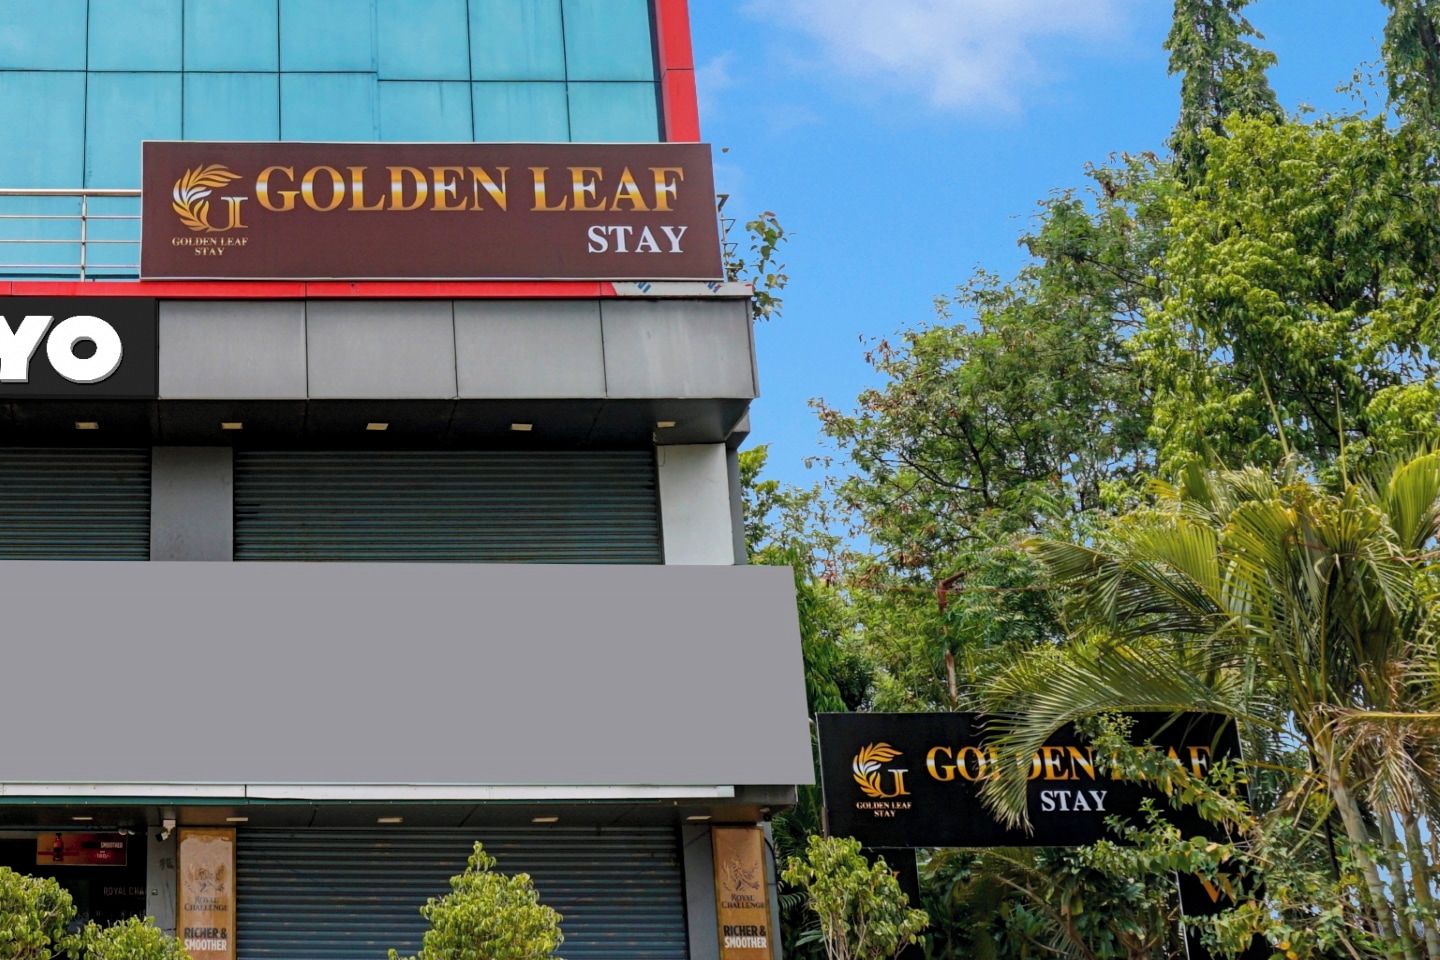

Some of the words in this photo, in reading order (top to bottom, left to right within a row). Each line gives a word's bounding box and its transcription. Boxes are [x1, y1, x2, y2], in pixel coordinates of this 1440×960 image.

[256, 165, 511, 213] GOLDEN
[527, 165, 685, 213] LEAF
[171, 237, 217, 246] GOLDEN
[221, 237, 249, 246] LEAF
[588, 225, 688, 254] STAY
[194, 247, 225, 256] STAY
[856, 801, 890, 810] GOLDEN
[891, 801, 912, 810] LEAF
[1040, 790, 1108, 812] STAY
[873, 810, 896, 818] STAY
[731, 894, 755, 902] ROYAL
[184, 903, 228, 912] CHALLENGE
[721, 901, 764, 909] CHALLENGE
[184, 927, 219, 939] RICHER
[219, 927, 227, 939] &
[723, 925, 759, 937] RICHER
[759, 925, 766, 937] &
[184, 939, 227, 951] SMOOTHER
[724, 936, 767, 949] SMOOTHER
